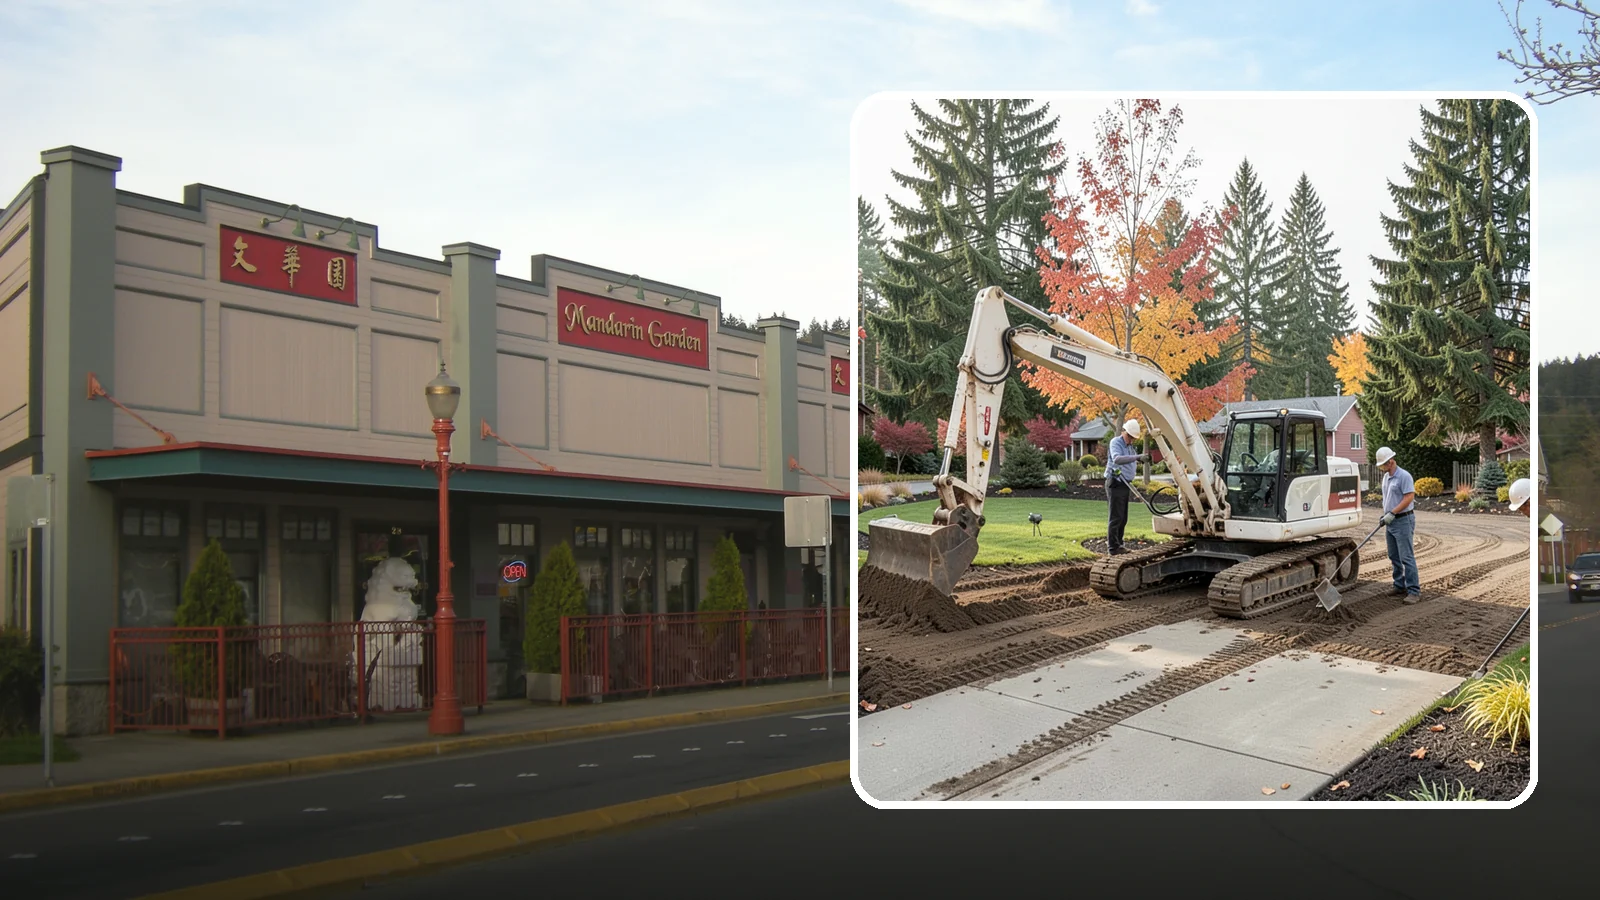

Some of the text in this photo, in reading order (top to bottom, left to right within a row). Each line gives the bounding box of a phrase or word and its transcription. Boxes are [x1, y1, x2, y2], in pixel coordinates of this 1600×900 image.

[564, 302, 702, 352] Mandarin Garden
[503, 565, 527, 578] OPEN
